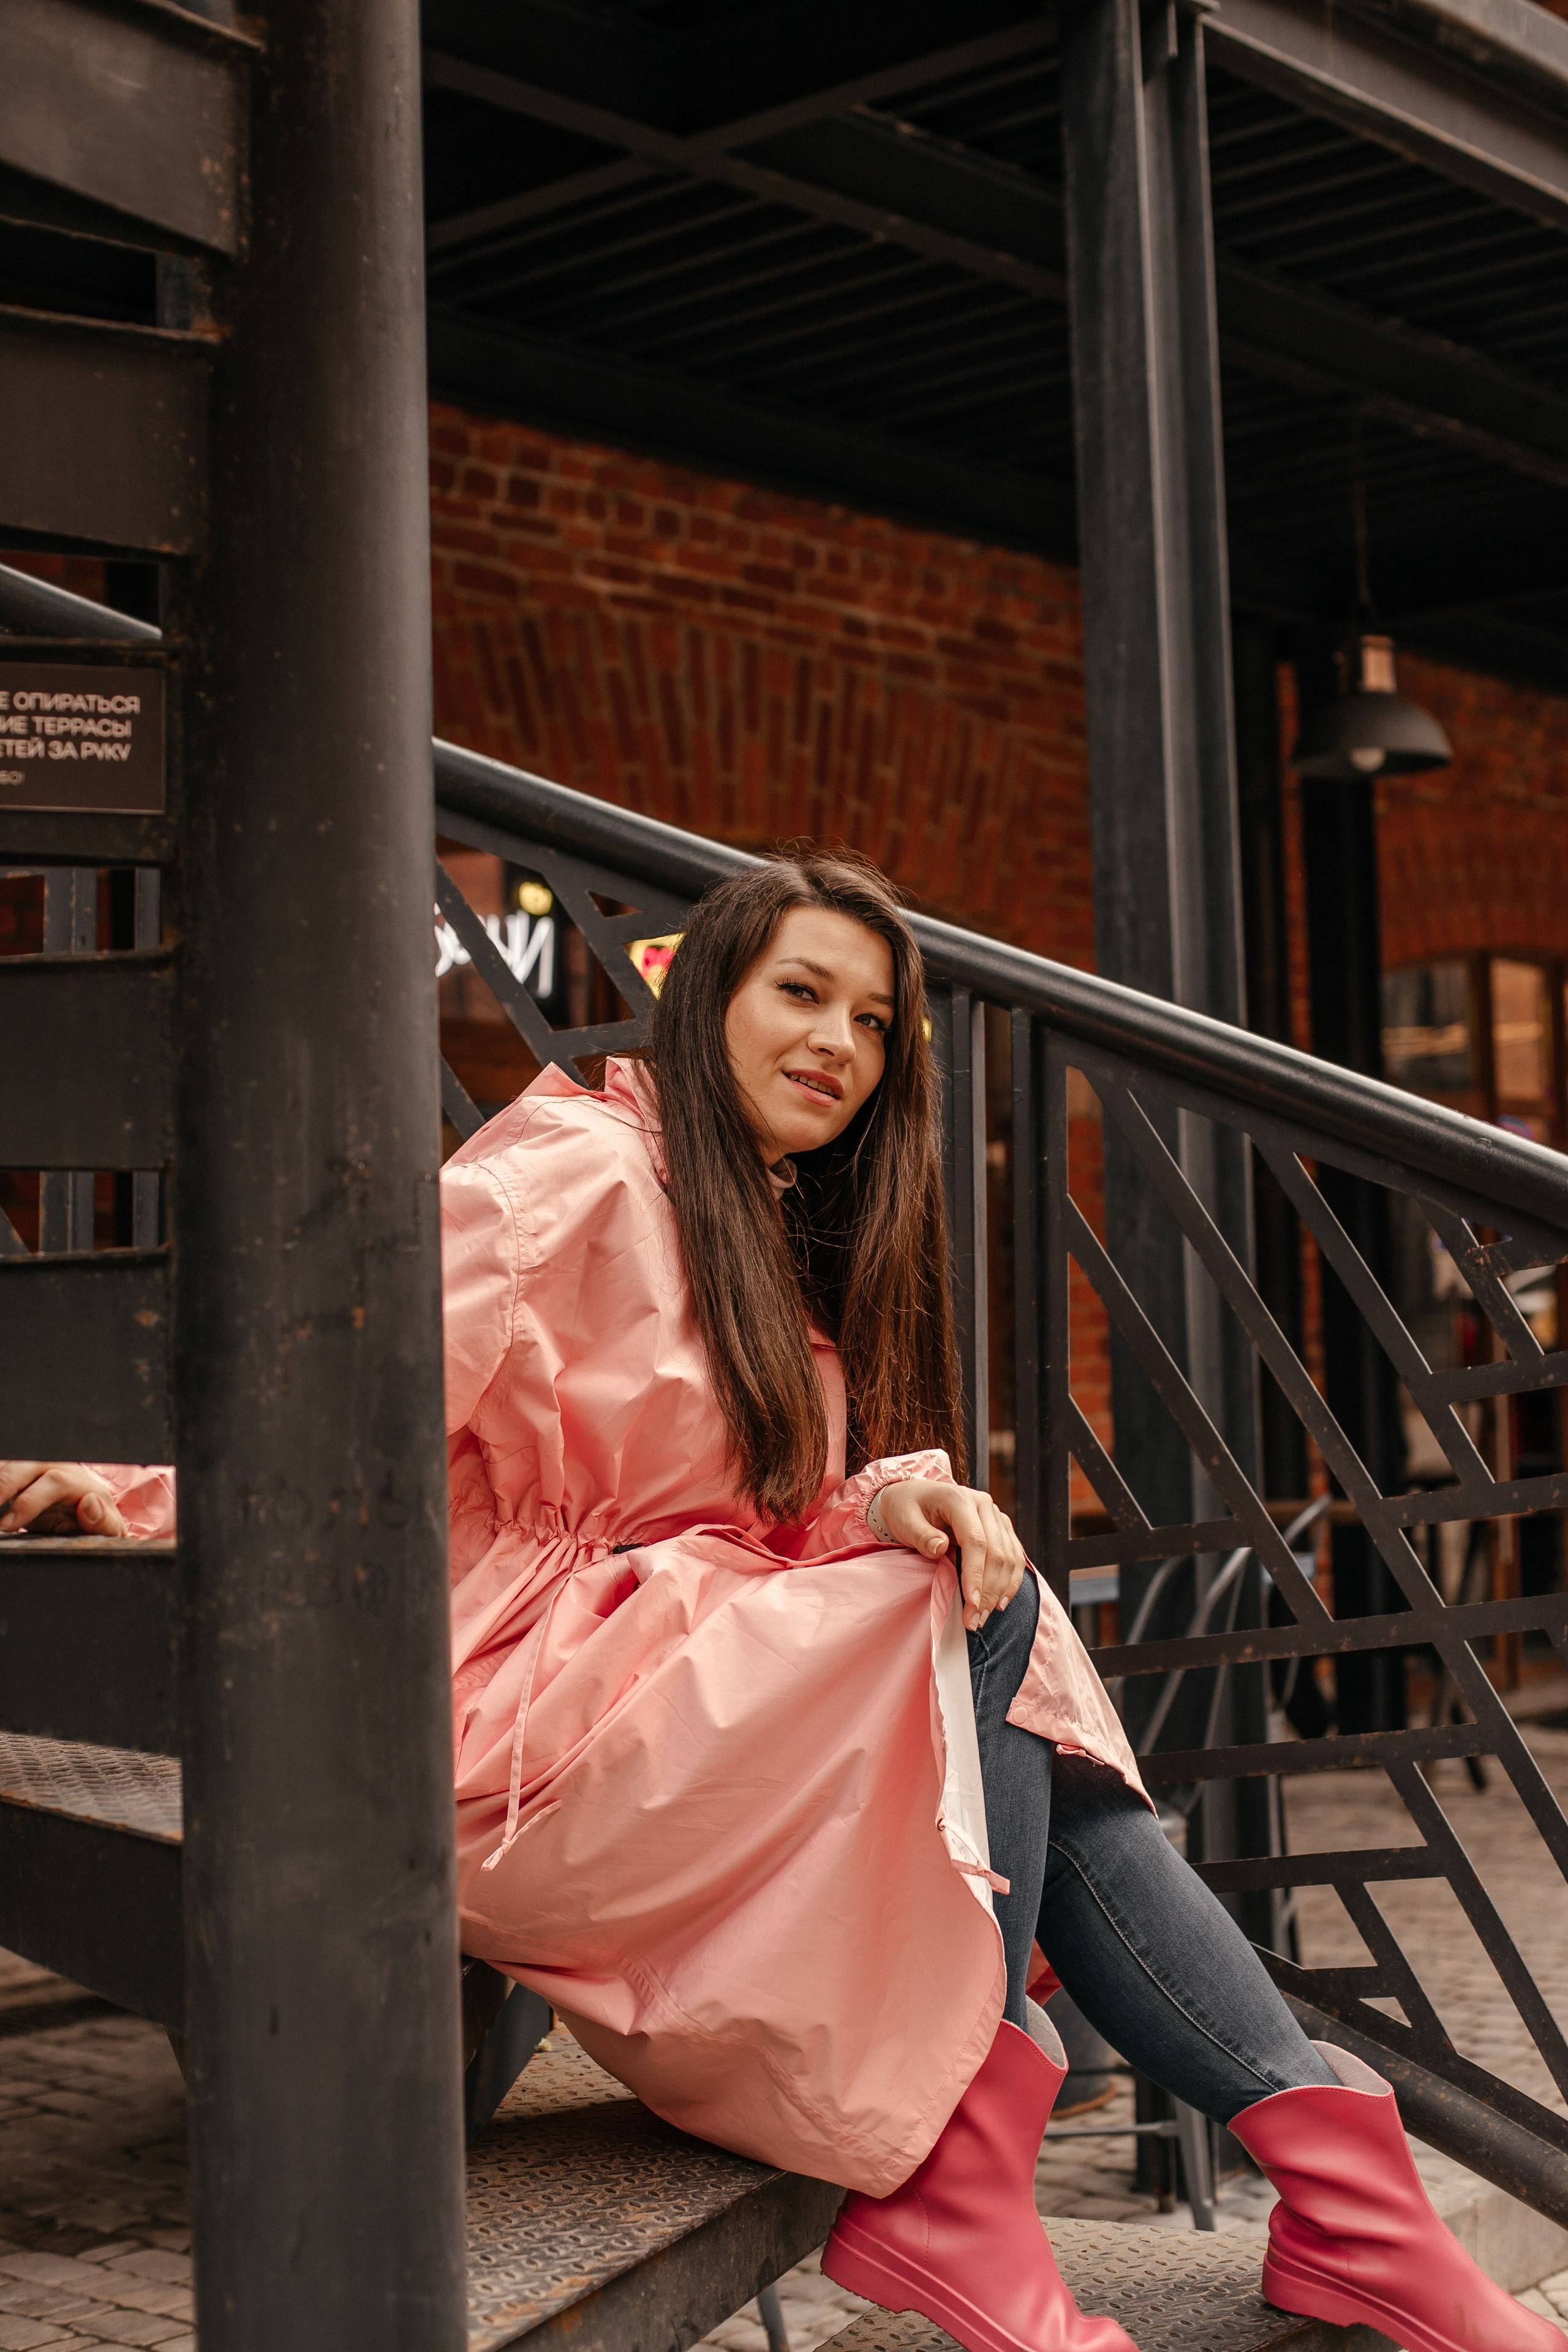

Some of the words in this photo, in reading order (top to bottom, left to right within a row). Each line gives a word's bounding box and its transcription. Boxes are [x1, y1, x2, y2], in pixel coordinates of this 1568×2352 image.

[13, 692, 141, 715] ОПИРАТЬСЯ
[31, 716, 132, 739] ТЕРРАСЫ
[48, 740, 79, 760] ЗА
[80, 741, 132, 761] РУКУ
